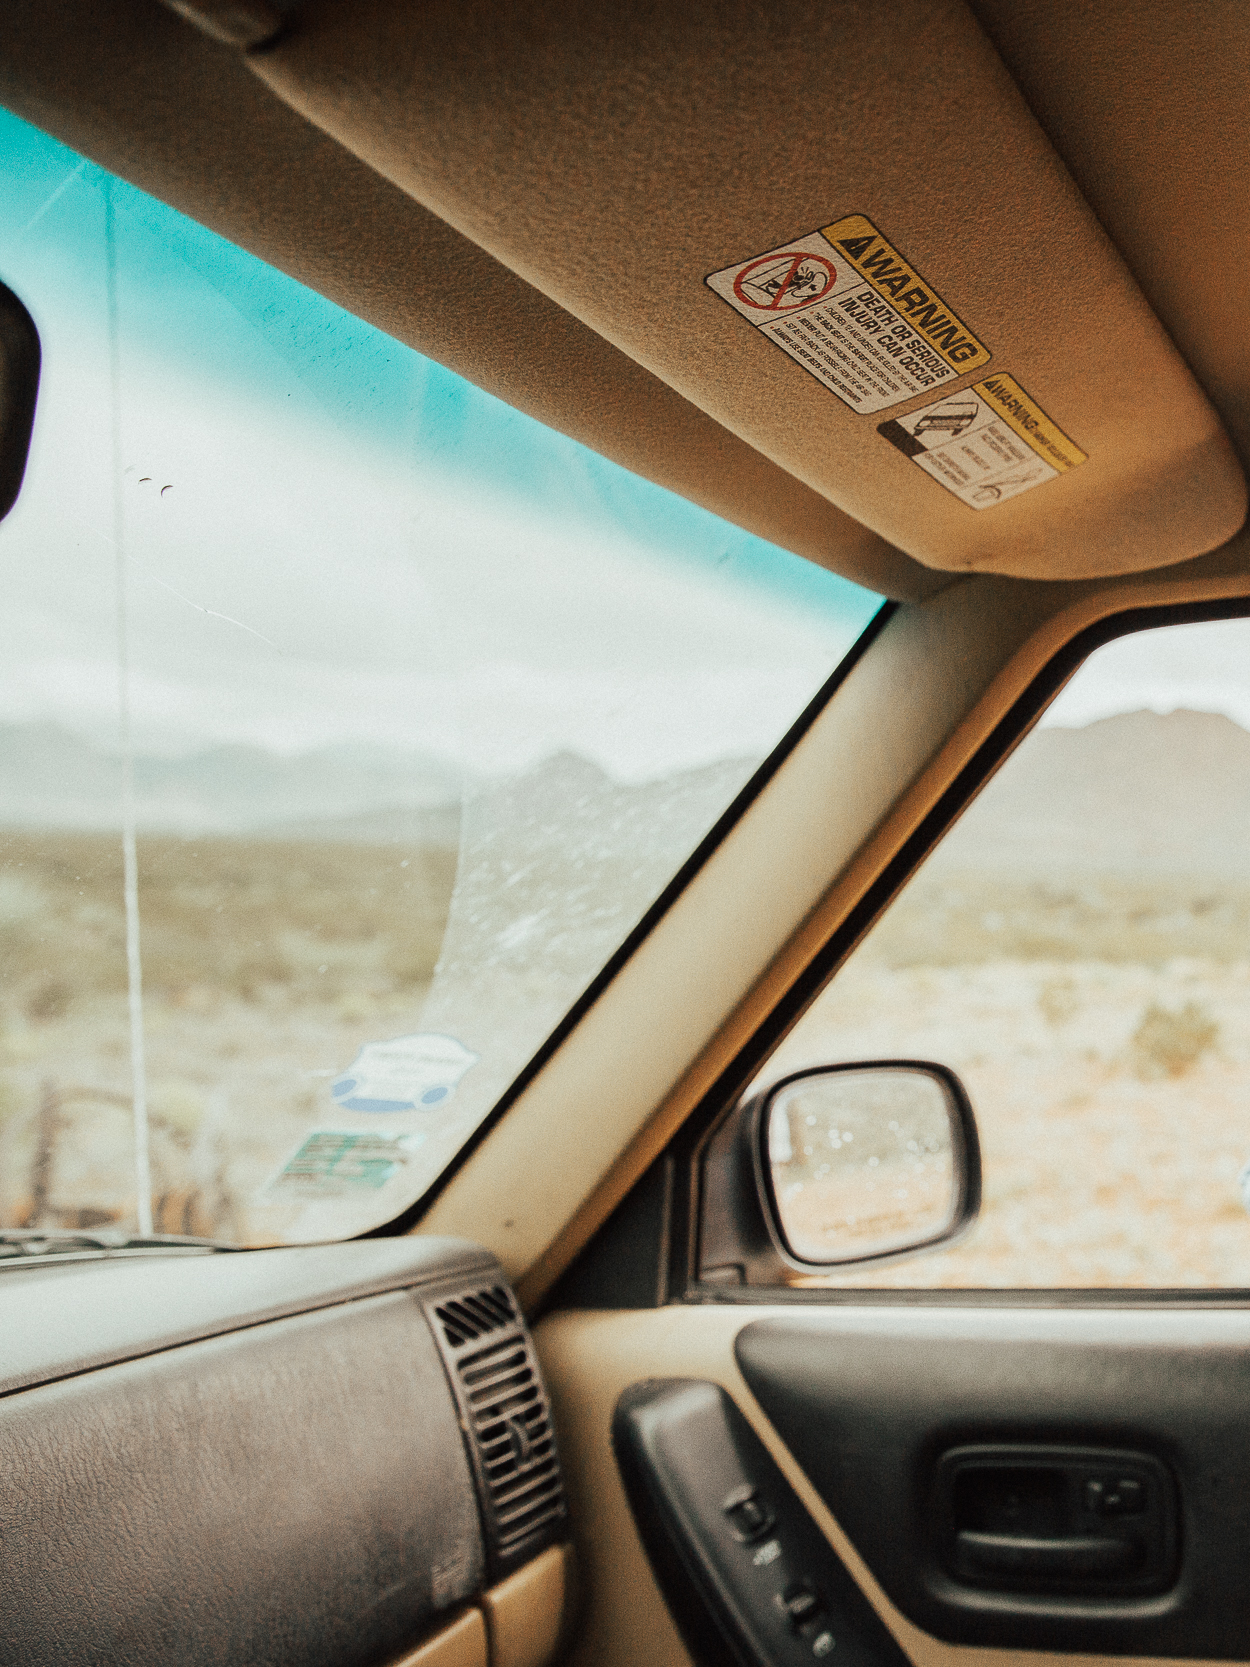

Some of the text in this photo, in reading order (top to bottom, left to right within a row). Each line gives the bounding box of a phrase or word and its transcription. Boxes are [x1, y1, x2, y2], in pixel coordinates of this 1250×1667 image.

[837, 296, 936, 387] INJURY CAN OCCUR
[855, 290, 951, 378] DEATH OR SERIOUS
[859, 247, 979, 364] WARNING
[991, 384, 1039, 430] WARNING
